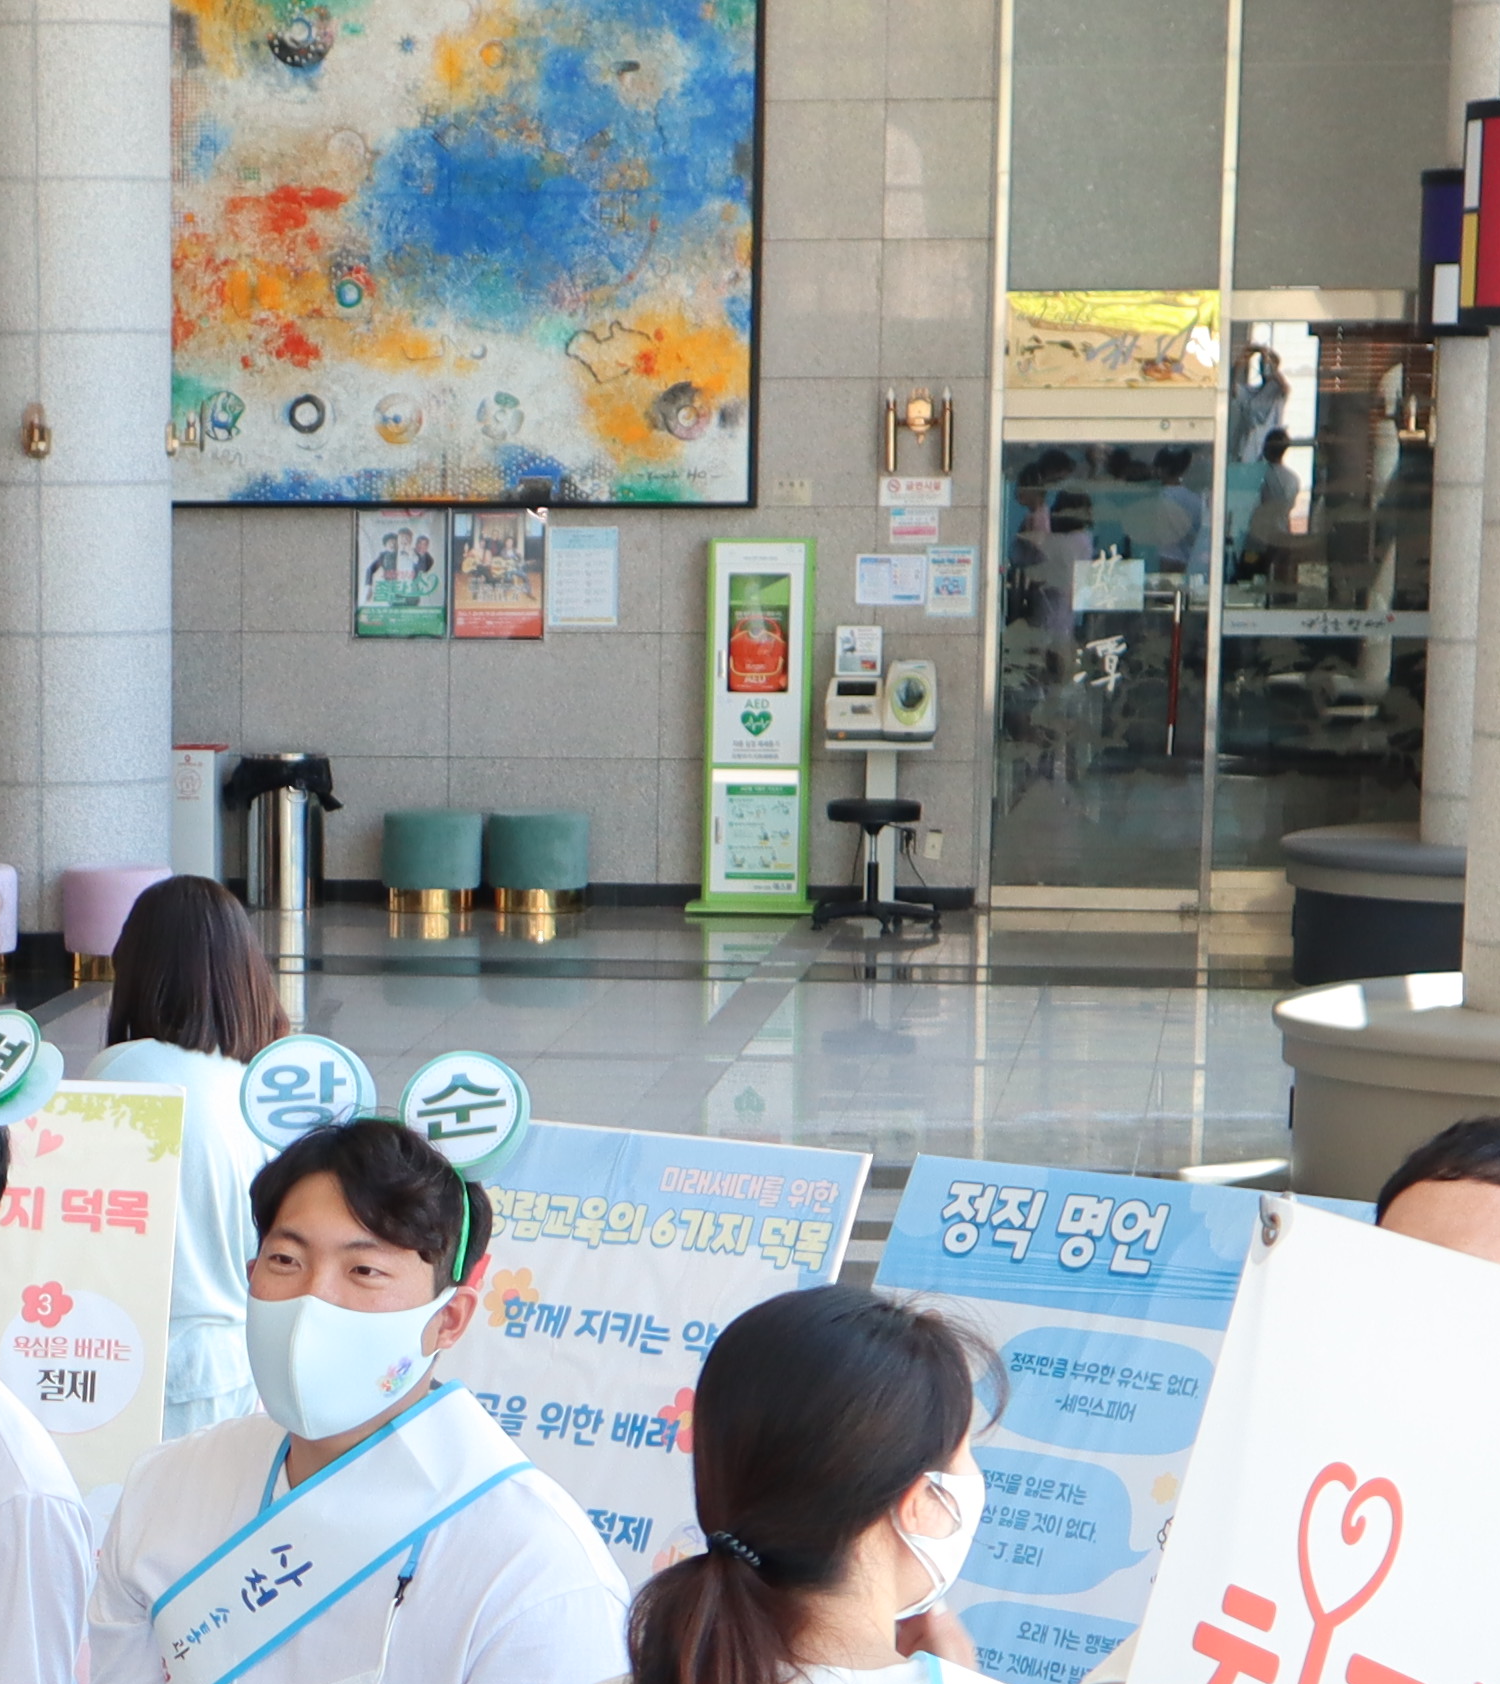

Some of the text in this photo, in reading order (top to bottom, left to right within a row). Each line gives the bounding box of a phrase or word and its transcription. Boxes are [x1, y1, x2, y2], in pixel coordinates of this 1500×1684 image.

[744, 698, 770, 709] AED
[256, 1060, 348, 1132] 왕
[415, 1071, 508, 1142] 순
[60, 1187, 150, 1236] 덕목
[659, 1164, 840, 1215] 미래세대를 위한
[650, 1208, 752, 1257] 6가지
[758, 1217, 834, 1273] 덕목
[940, 1179, 1172, 1278] 정직 명언
[36, 1293, 52, 1316] 3
[503, 1295, 720, 1362] 함께 지키는 약
[13, 1335, 132, 1361] 욕심을 버리는
[37, 1367, 97, 1404] 절제
[1009, 1351, 1200, 1400] 정직만큼 부유한 유산도 없다.
[537, 1401, 682, 1454] 위한 배려
[1024, 1475, 1056, 1502] 잃은
[1056, 1480, 1089, 1507] 자는
[997, 1508, 1032, 1533] 잃을
[1031, 1512, 1063, 1538] 것이
[1065, 1518, 1098, 1545] 없다.
[1011, 1543, 1045, 1569] 릴리
[171, 1543, 314, 1661] 사천 소통과
[1016, 1621, 1051, 1646] 오래
[1051, 1627, 1082, 1652] 가는
[973, 1645, 1068, 1684] 직한 것에서만
